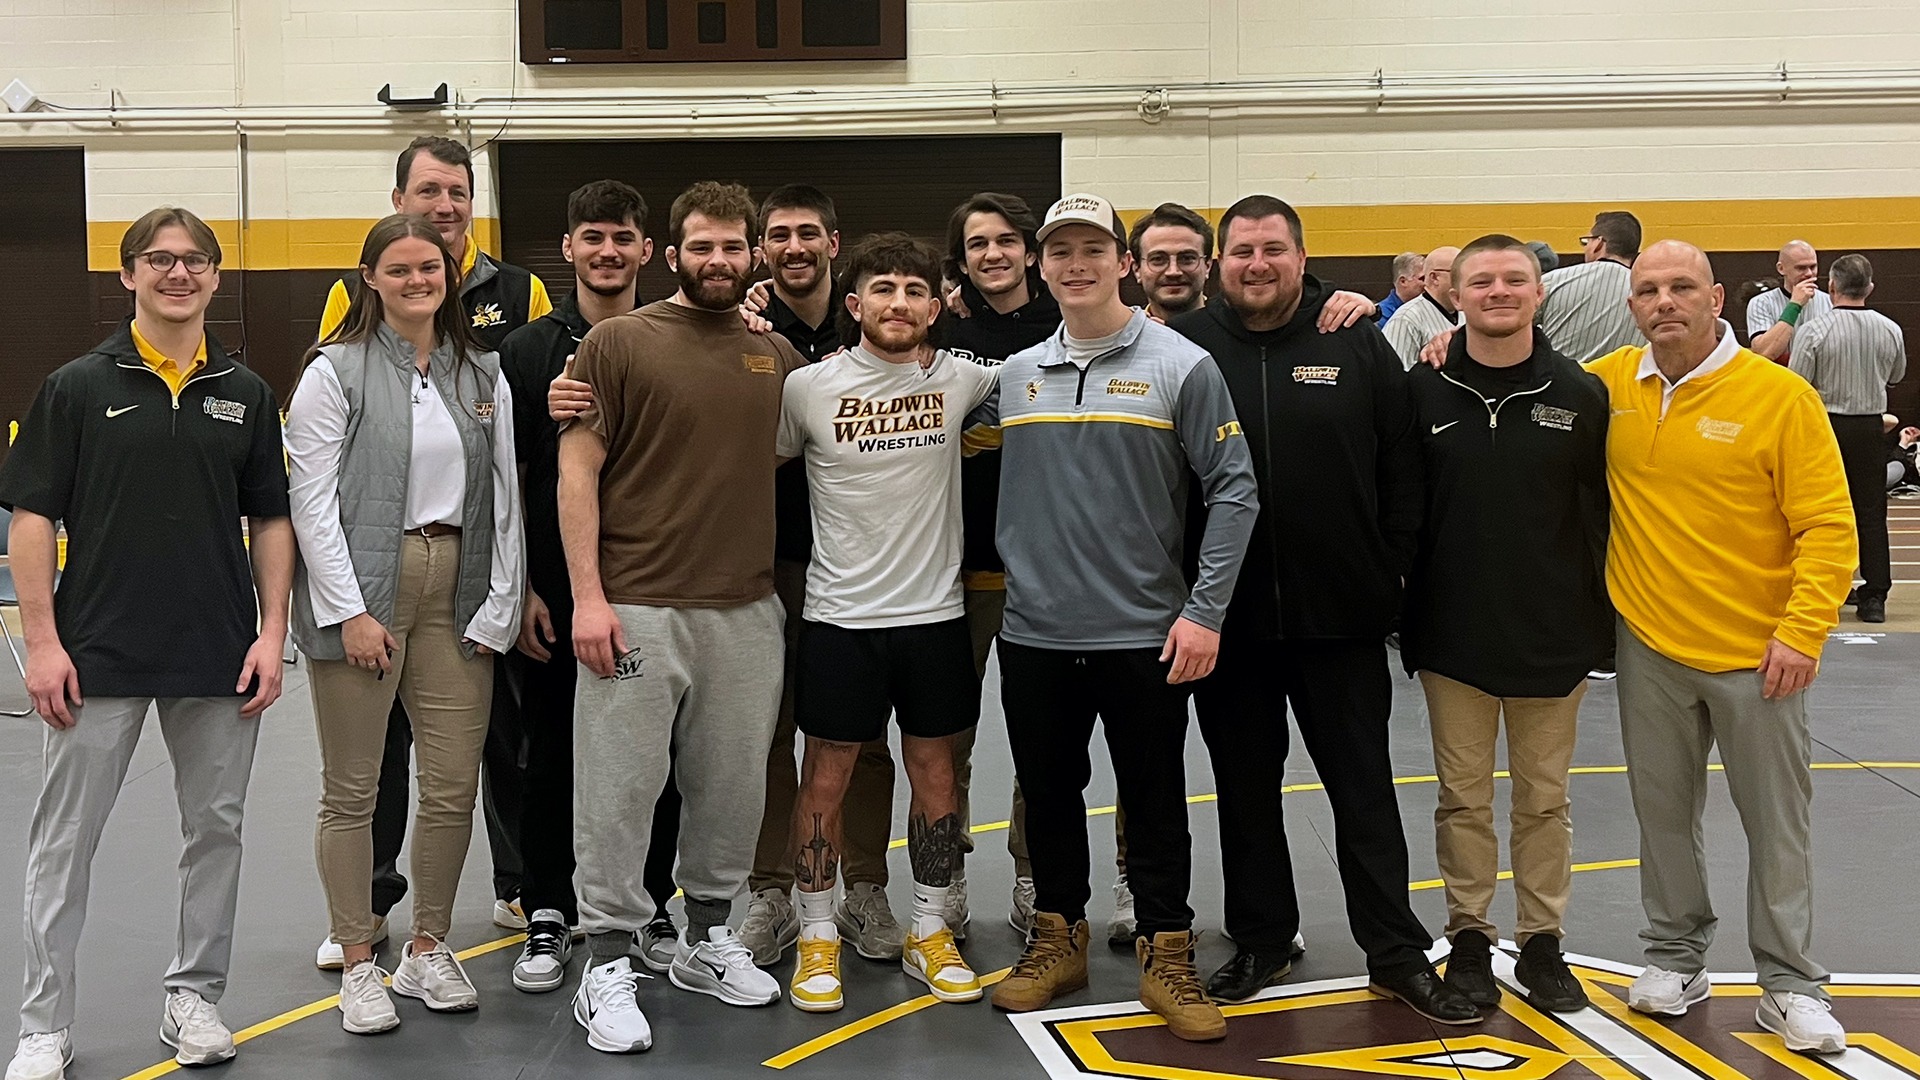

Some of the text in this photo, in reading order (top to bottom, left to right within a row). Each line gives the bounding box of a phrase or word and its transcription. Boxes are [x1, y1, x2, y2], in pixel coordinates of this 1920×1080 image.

[1106, 386, 1147, 396] WALLACE
[1108, 378, 1151, 390] BALDWIN
[832, 391, 945, 419] BALDWIN
[832, 412, 944, 443] WALLACE
[858, 434, 946, 452] WRESTLING
